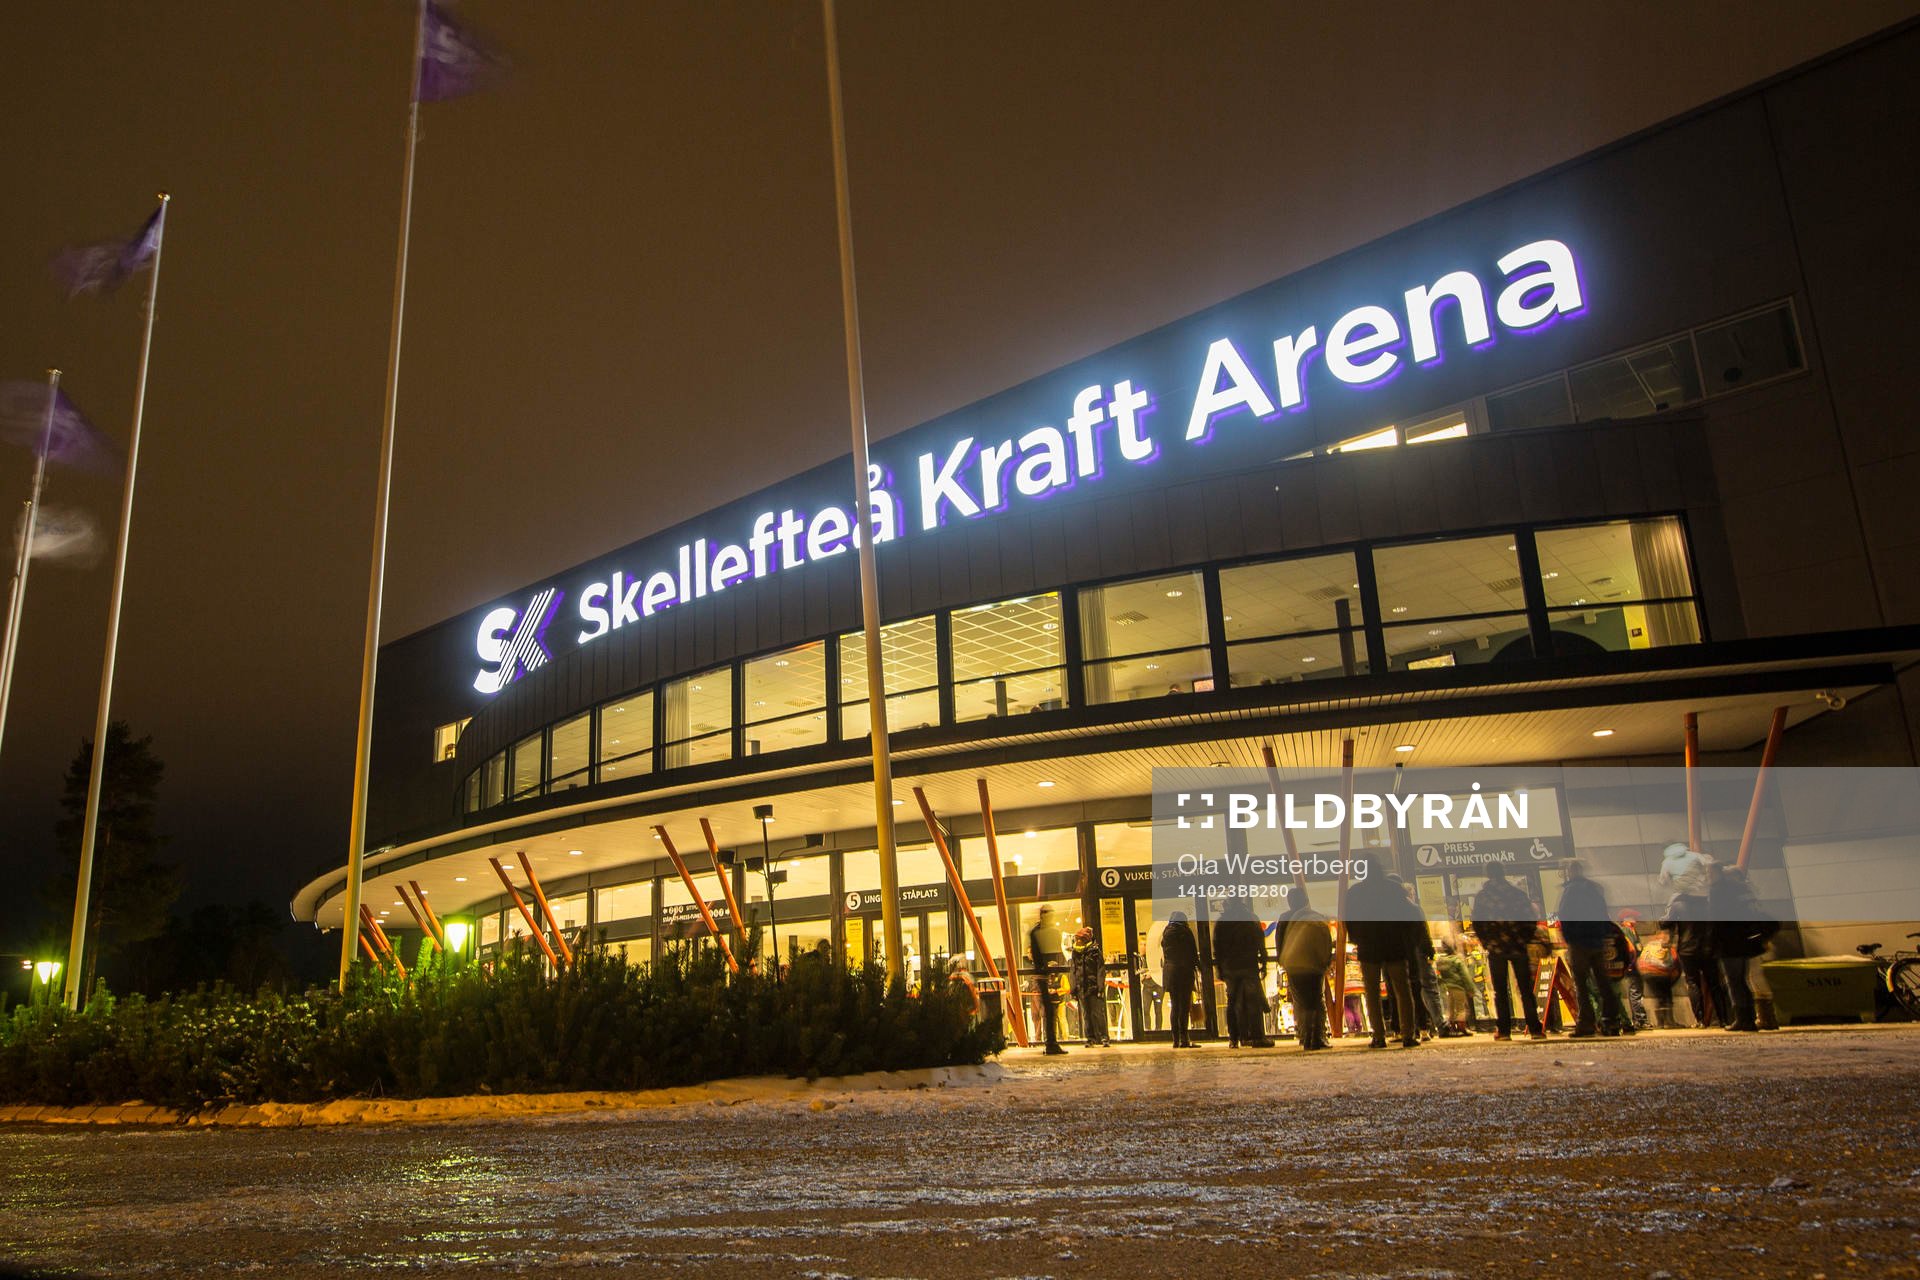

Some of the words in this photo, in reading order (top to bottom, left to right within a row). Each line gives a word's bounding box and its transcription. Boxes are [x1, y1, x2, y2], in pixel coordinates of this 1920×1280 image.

[577, 463, 895, 645] Skellefteå
[918, 379, 1154, 531] Kraft
[1184, 239, 1582, 442] Arena
[1443, 842, 1476, 854] PRESS
[1445, 850, 1516, 866] FUNKTIONÄR
[1124, 871, 1159, 881] VUXEN,
[902, 889, 939, 901] STÅPLATS
